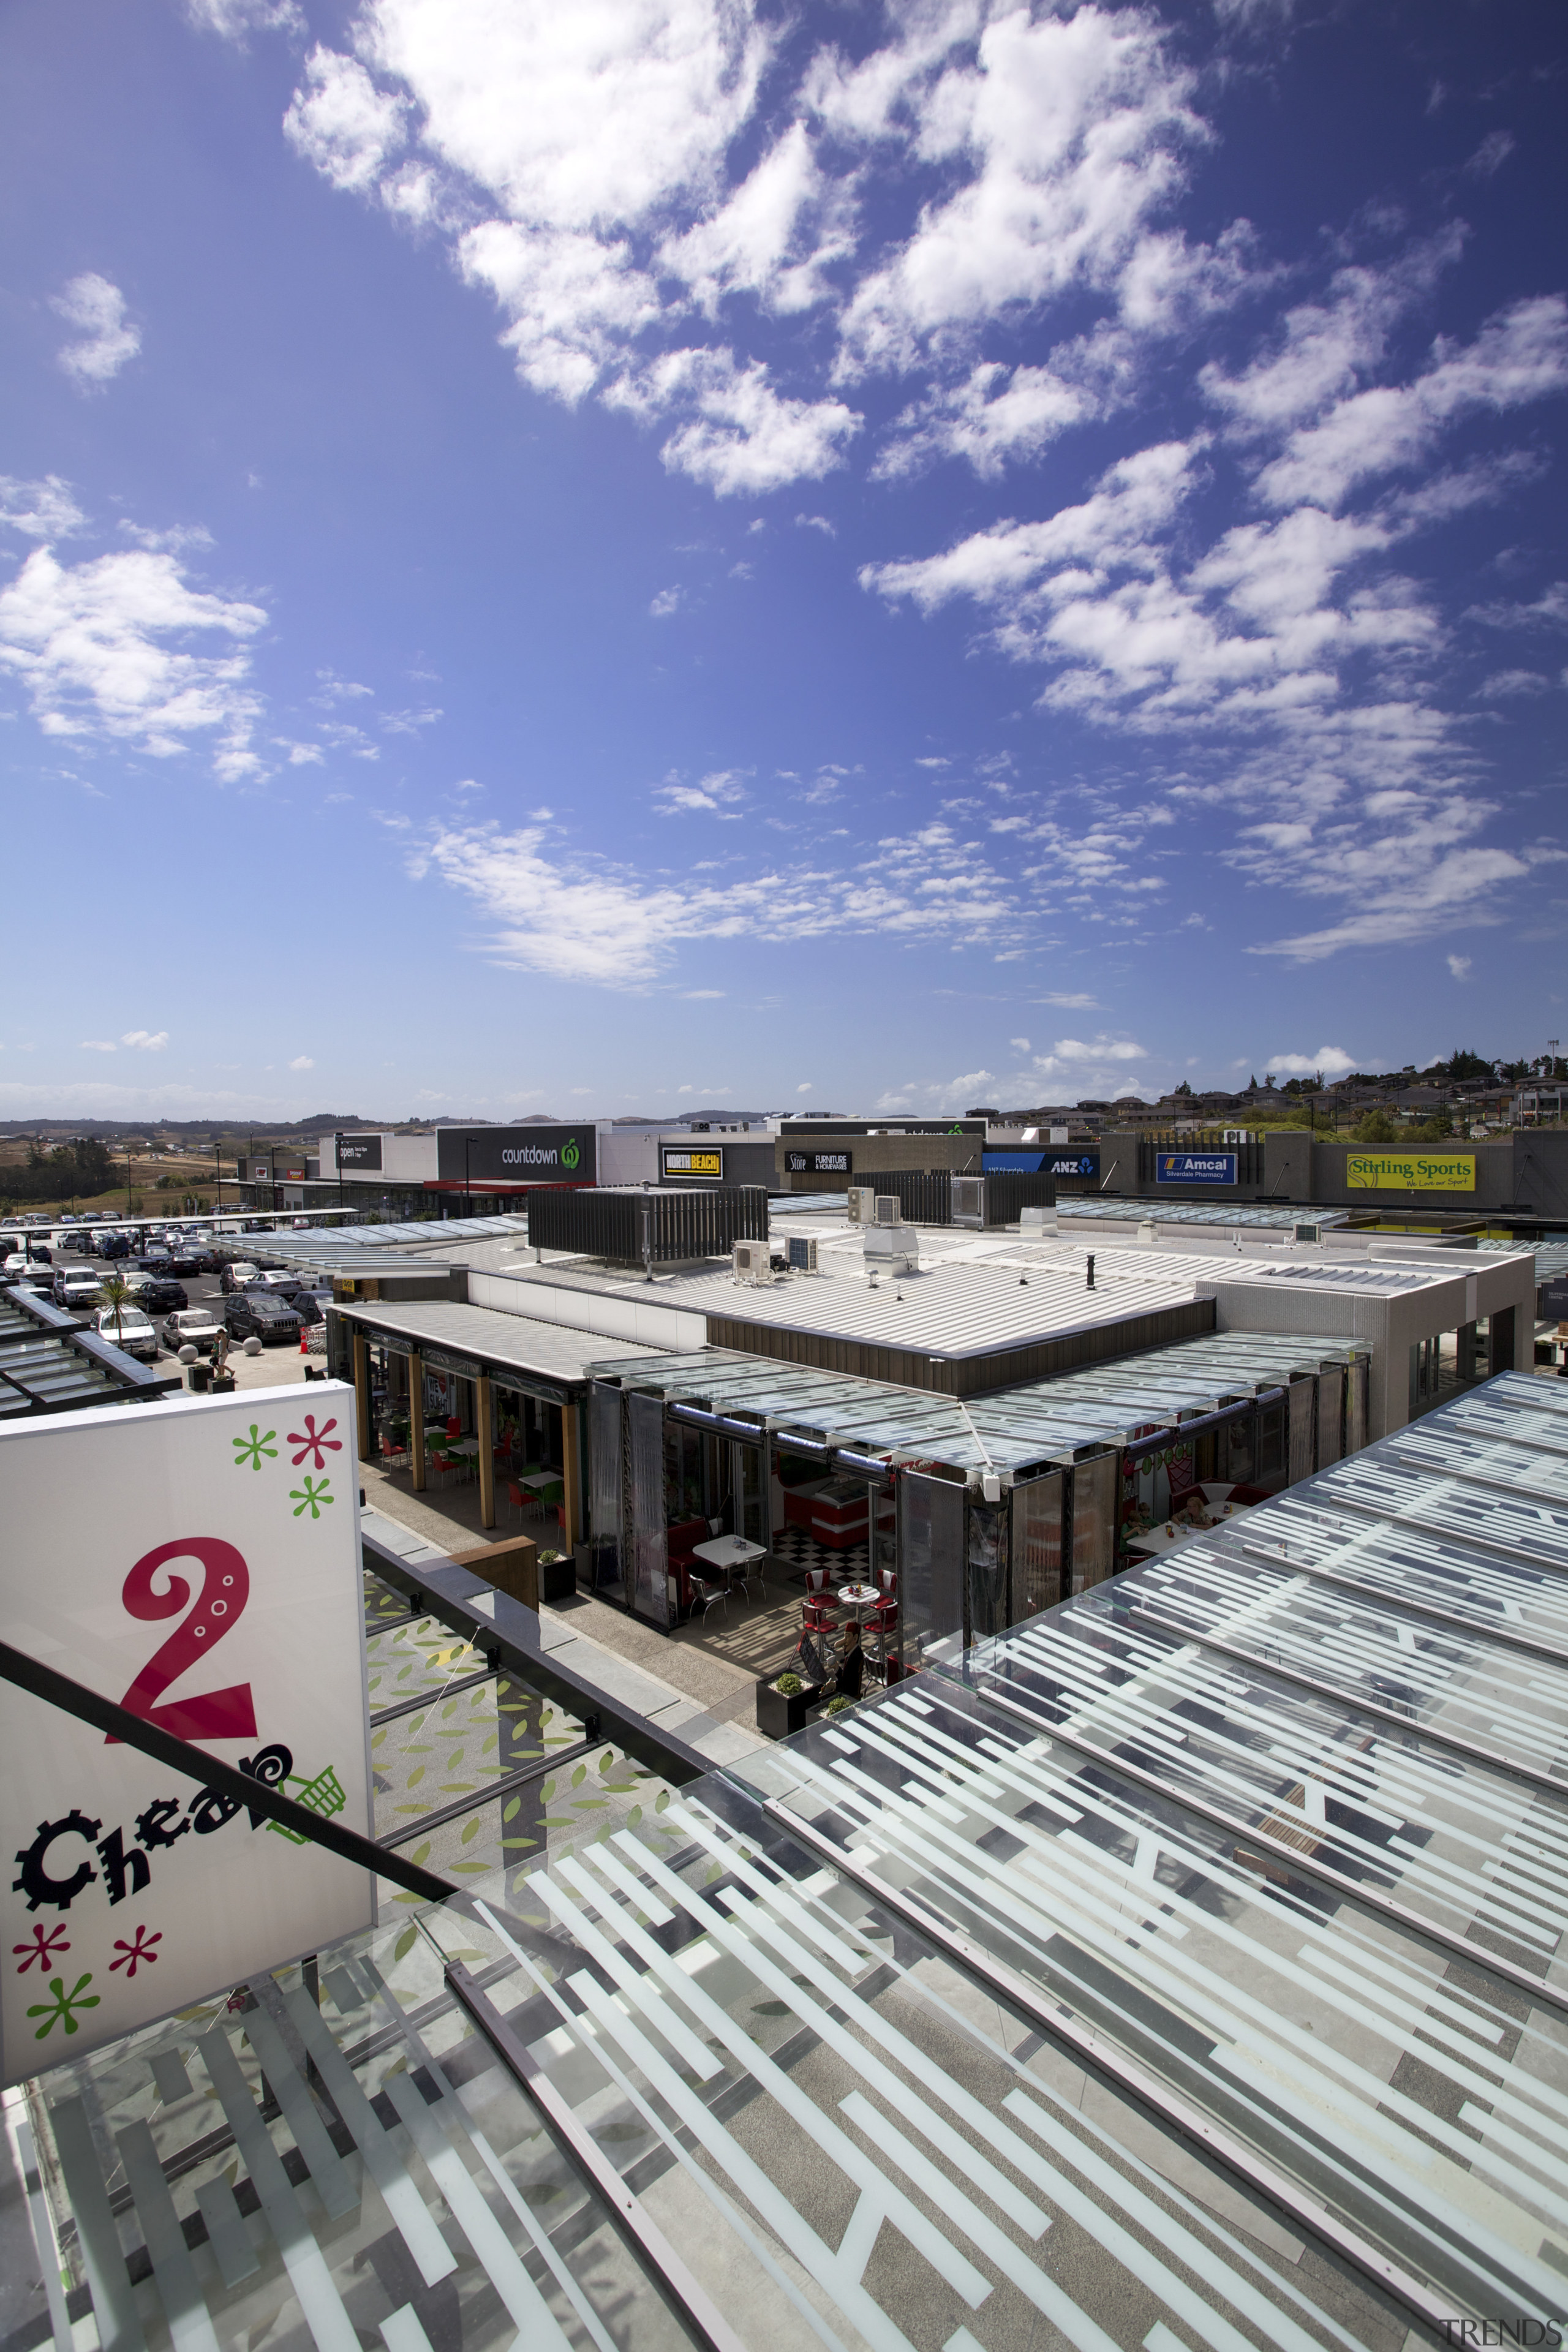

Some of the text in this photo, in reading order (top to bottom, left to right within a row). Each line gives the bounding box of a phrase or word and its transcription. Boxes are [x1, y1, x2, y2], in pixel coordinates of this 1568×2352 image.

[340, 1147, 354, 1160] open
[502, 1145, 557, 1164] countdown
[815, 1155, 846, 1164] FURNITURE
[666, 1155, 717, 1169] NORTH BEACH
[790, 1154, 806, 1170] Store
[1050, 1161, 1078, 1173] ANZ
[1185, 1158, 1227, 1170] Amcal
[1352, 1159, 1471, 1178] Stirling Sports
[1447, 1177, 1469, 1187] Sport
[104, 1537, 258, 1744] 2
